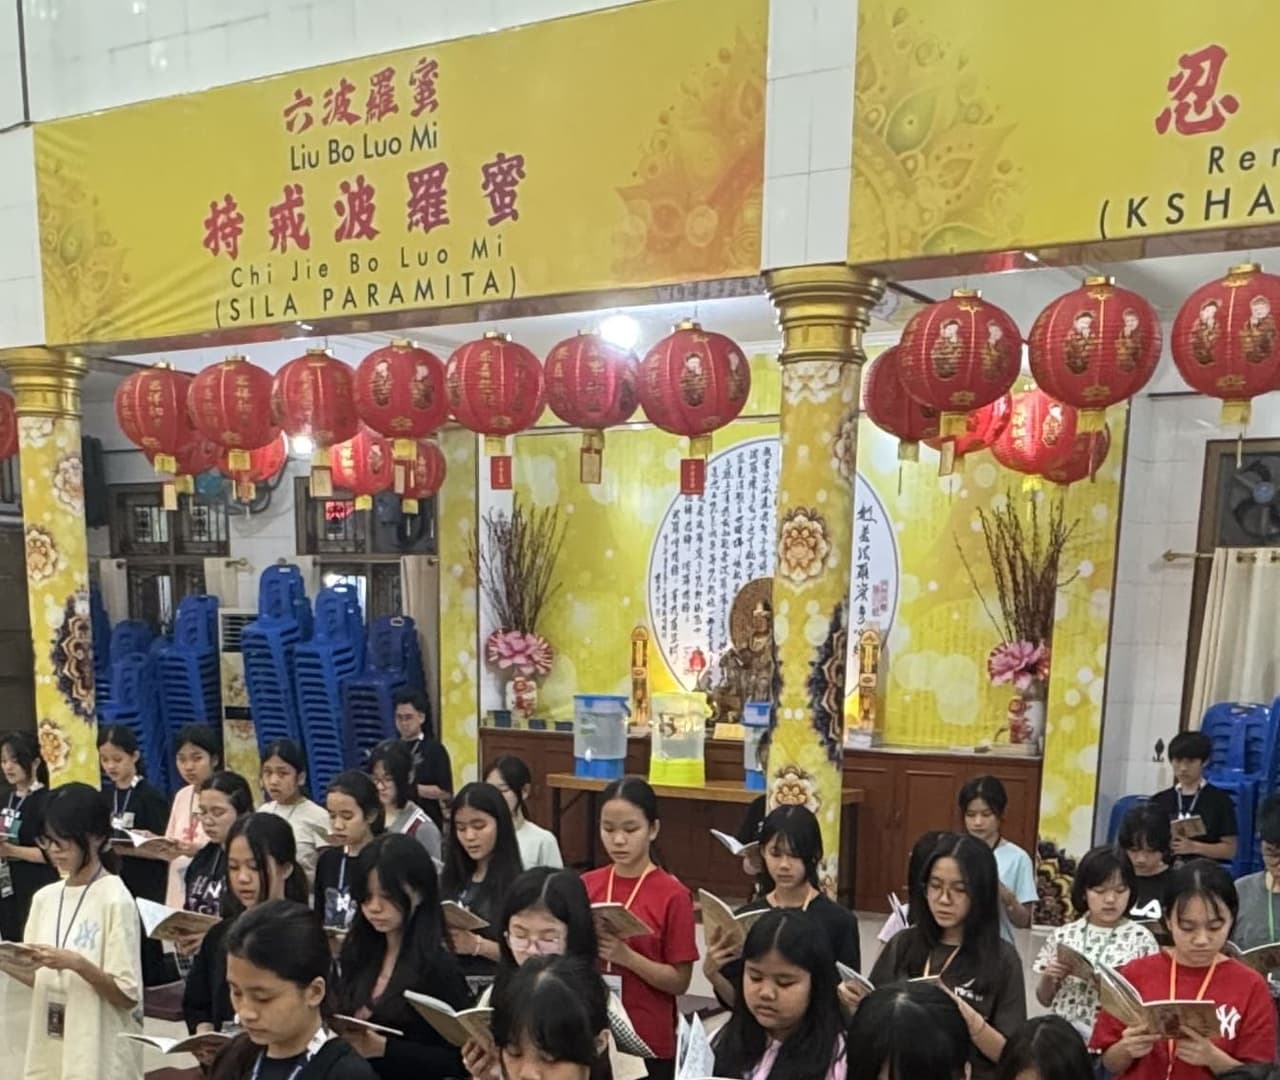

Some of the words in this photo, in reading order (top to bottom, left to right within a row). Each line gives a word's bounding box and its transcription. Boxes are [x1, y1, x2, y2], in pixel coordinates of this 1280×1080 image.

[284, 56, 439, 134] 六波羅蜜
[291, 144, 319, 171] Liu
[328, 138, 355, 165] Bo
[363, 133, 402, 160] Luo
[410, 122, 438, 152] Mi
[203, 152, 526, 261] 持戒波羅蜜
[231, 263, 272, 288] Chi
[292, 260, 329, 282] Jie
[350, 253, 379, 274] Bo
[401, 247, 449, 268] Luo
[471, 234, 502, 259] Mi
[215, 293, 298, 329] (SILA
[323, 266, 516, 312] PARAMITA)
